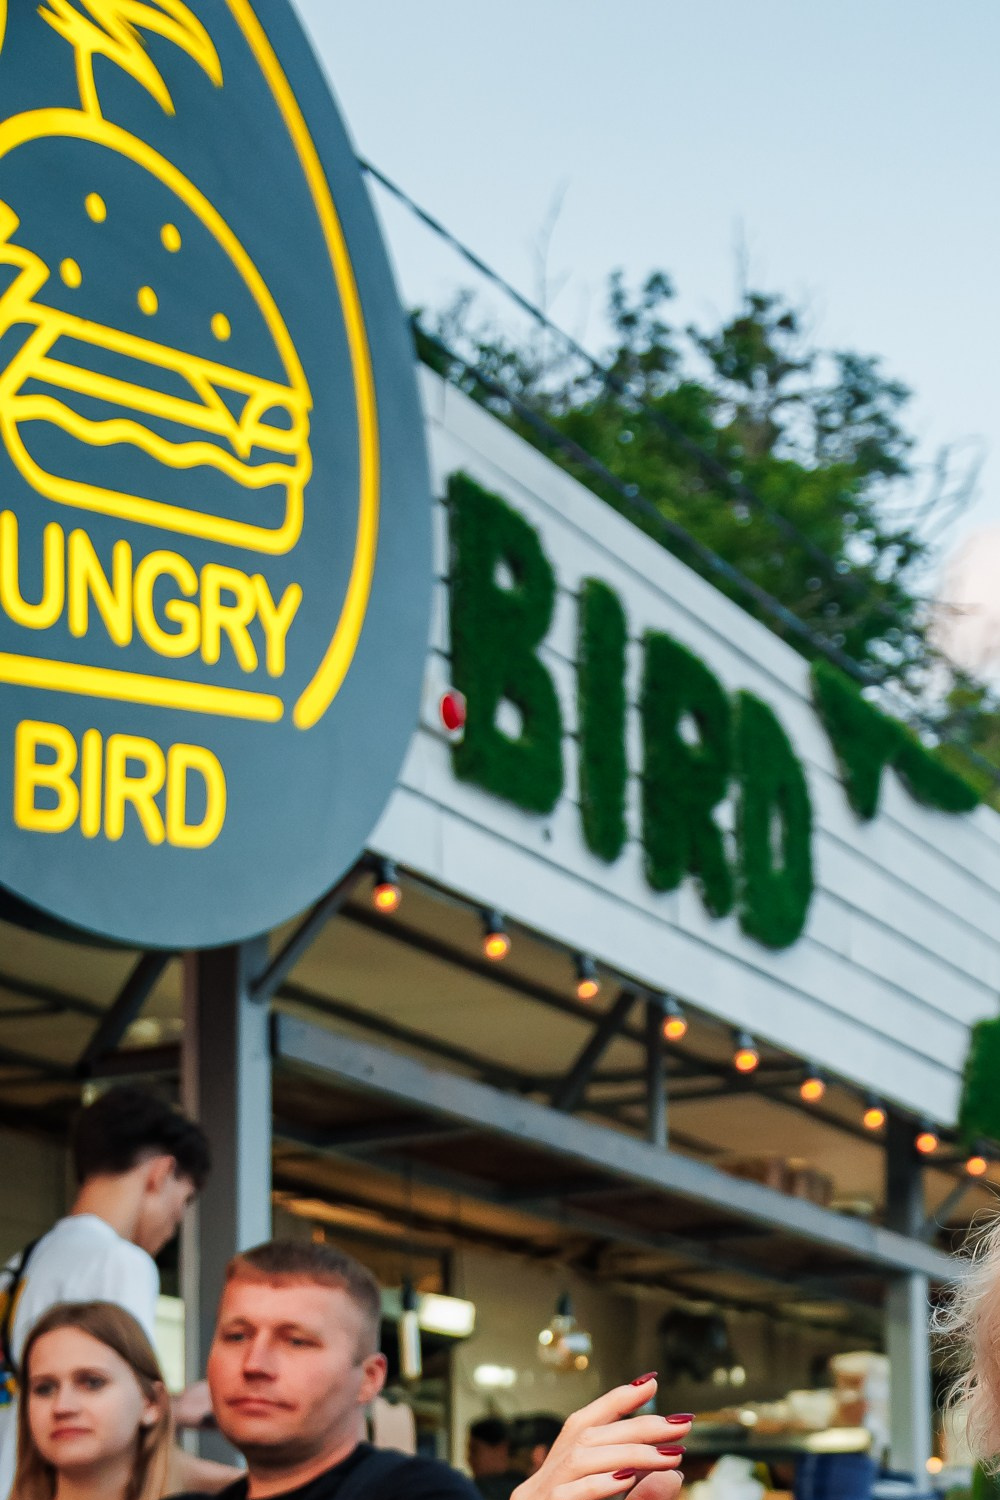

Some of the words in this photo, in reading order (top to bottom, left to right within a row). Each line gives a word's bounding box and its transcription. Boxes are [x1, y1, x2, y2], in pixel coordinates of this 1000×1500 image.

[0, 509, 303, 678] UNGRY
[14, 719, 228, 850] BIRD
[447, 470, 815, 951] BIRD
